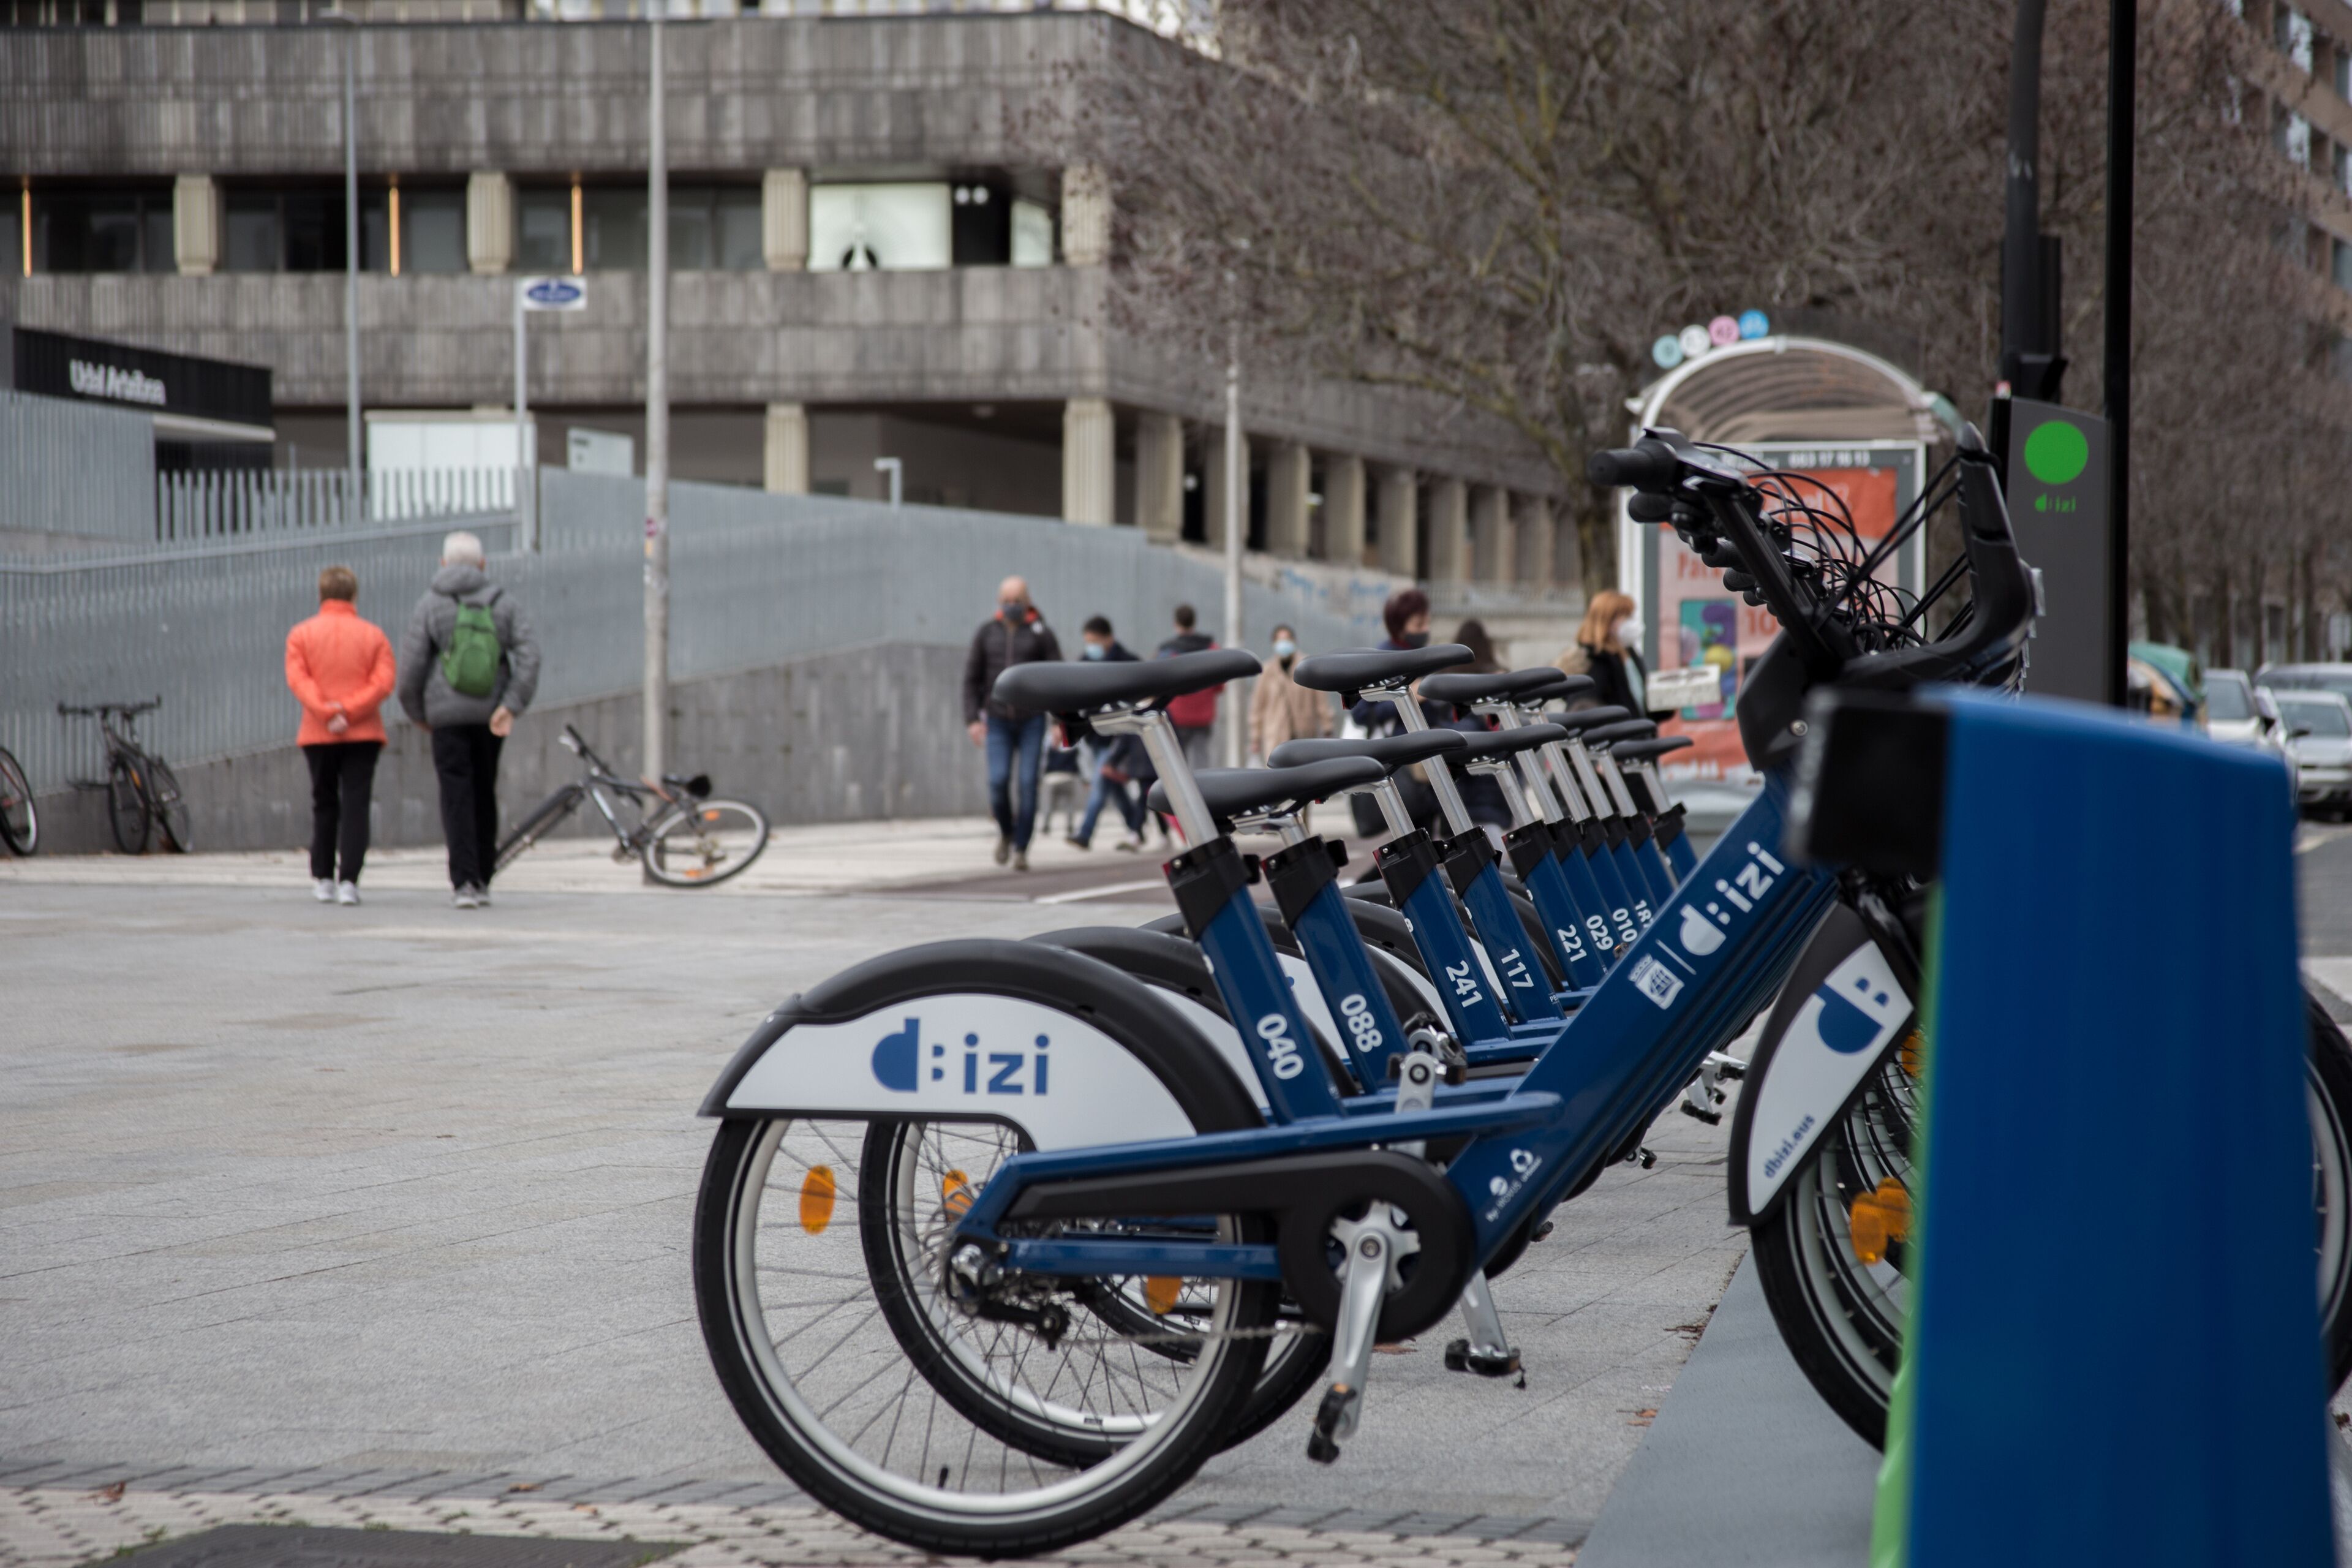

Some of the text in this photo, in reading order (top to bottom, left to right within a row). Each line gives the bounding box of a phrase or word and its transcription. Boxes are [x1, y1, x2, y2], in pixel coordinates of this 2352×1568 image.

[1557, 924, 1587, 962] 221
[1586, 915, 1613, 950] 029
[1612, 908, 1638, 942] 010
[1446, 960, 1483, 1008] 241
[1501, 948, 1534, 987] 117
[1340, 993, 1382, 1053] 088
[1256, 1013, 1304, 1080] 040
[1765, 1115, 1815, 1178] dbizi.eus
